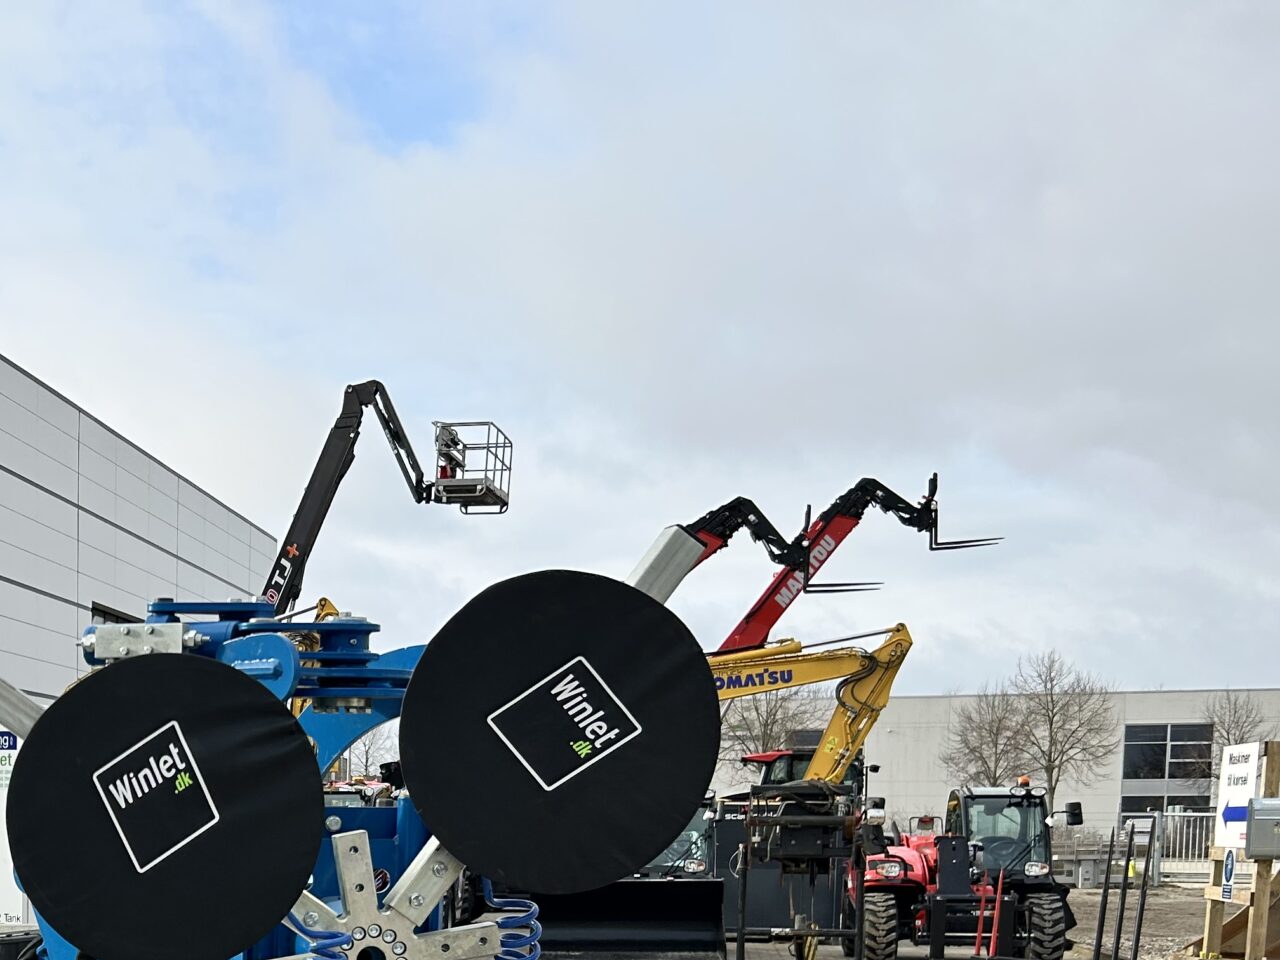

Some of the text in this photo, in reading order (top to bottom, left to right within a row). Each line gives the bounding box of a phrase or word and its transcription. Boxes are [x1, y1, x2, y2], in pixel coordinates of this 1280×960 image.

[714, 668, 793, 690] OMATSU
[550, 673, 620, 749] Winlet
[570, 740, 593, 758] .dk
[108, 742, 186, 809] Winlet
[174, 771, 194, 794] .dk
[3, 912, 22, 922] Tank
